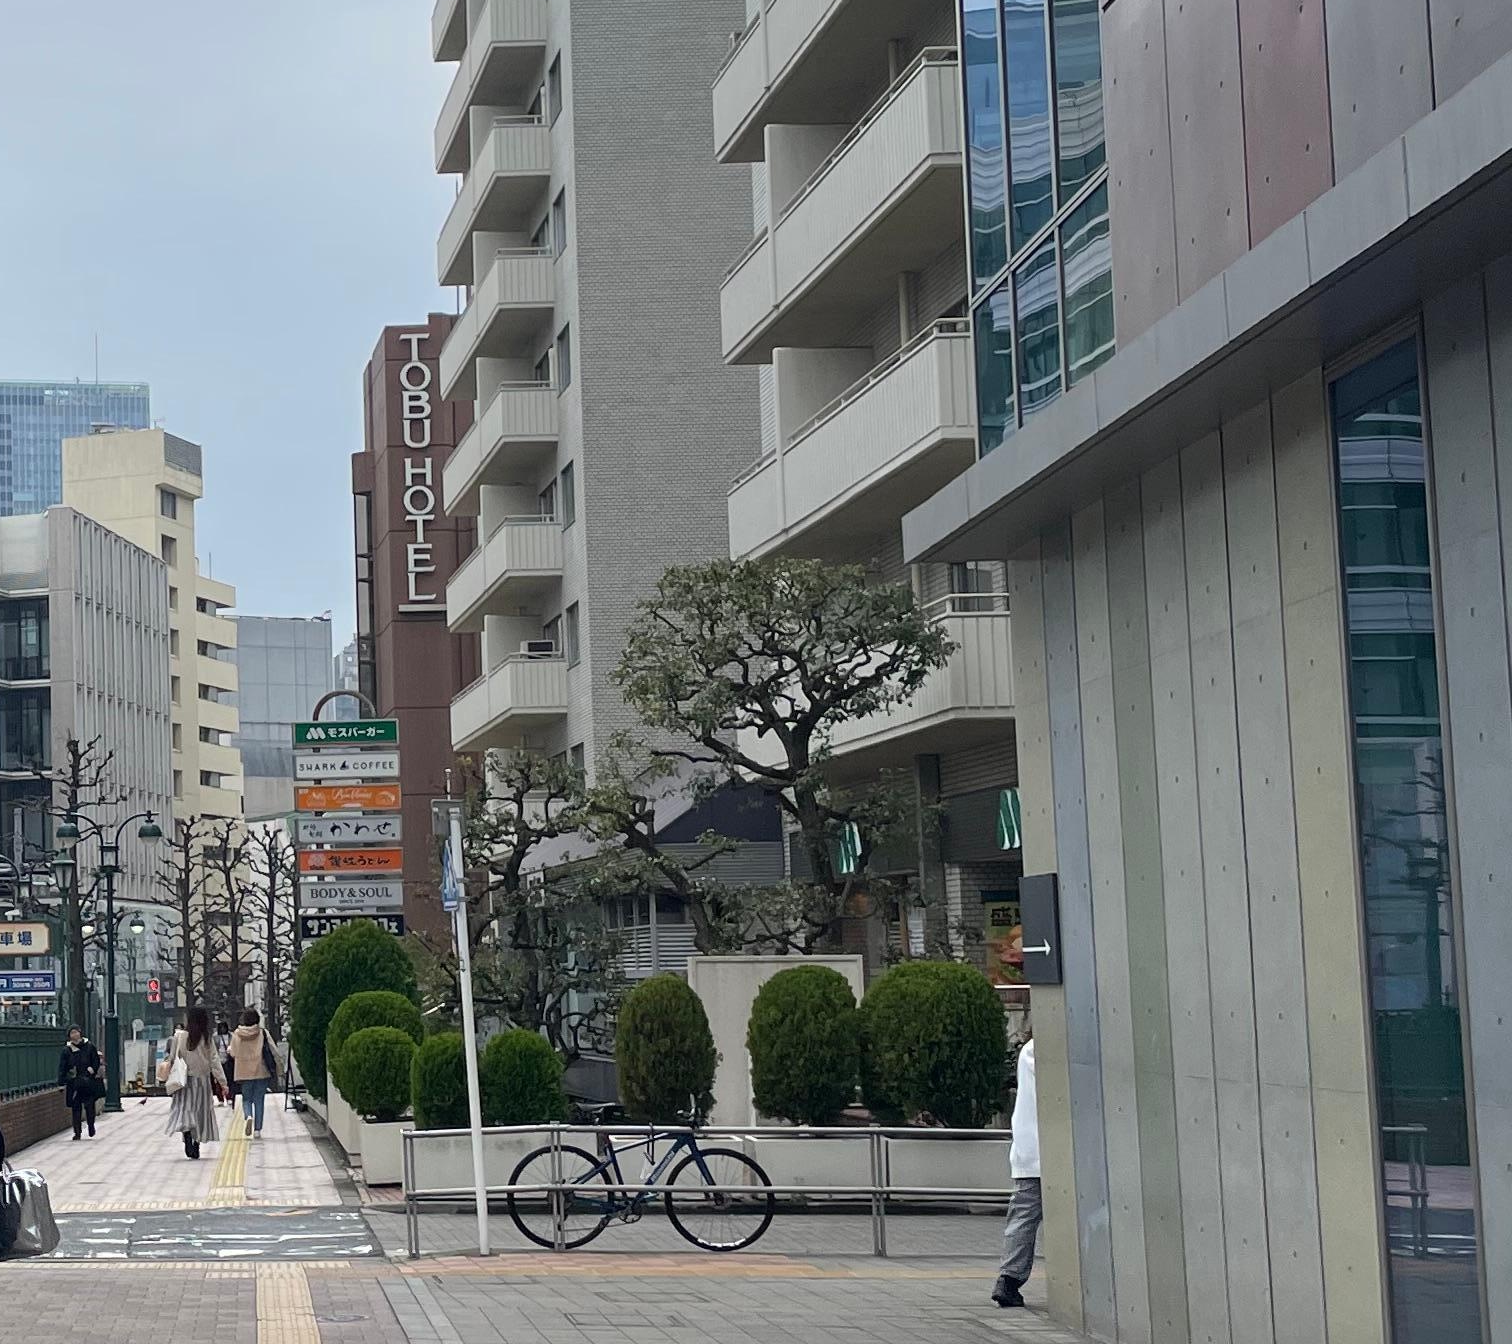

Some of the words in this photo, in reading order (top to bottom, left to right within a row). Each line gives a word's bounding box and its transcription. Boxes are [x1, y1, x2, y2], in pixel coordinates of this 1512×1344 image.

[399, 333, 431, 448] TOBU
[403, 457, 436, 601] HOTEL
[328, 727, 385, 738] モスバーガー
[298, 762, 337, 771] SHARK
[352, 760, 395, 770] COFFEE
